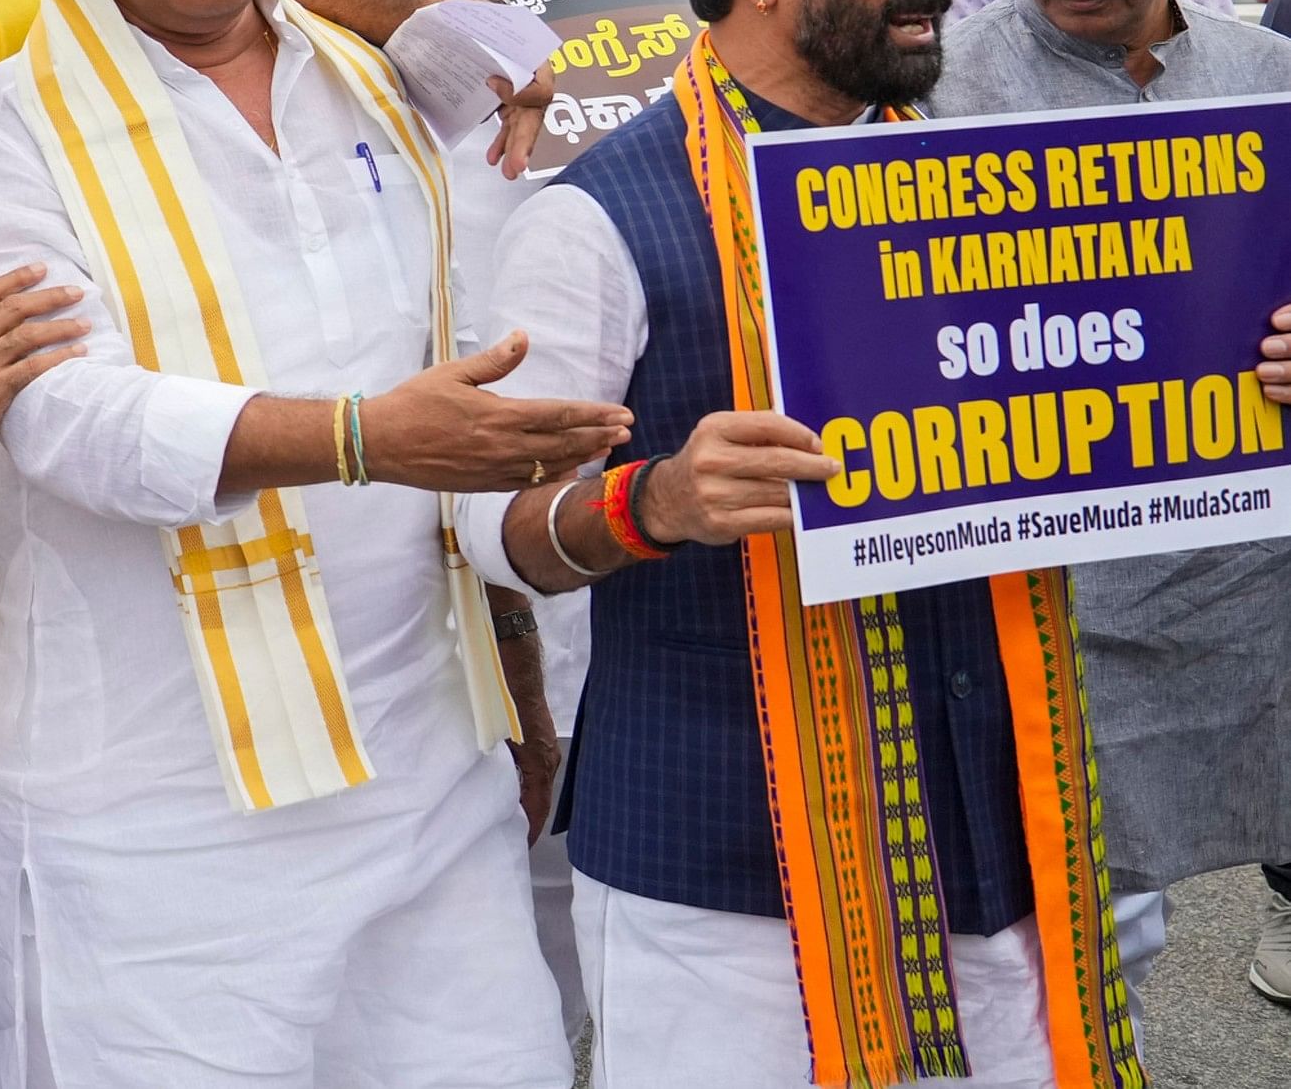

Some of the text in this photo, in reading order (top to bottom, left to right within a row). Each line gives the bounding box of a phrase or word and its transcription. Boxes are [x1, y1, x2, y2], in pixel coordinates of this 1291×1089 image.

[795, 131, 1267, 232] CONGRESS RETURNS
[878, 216, 1193, 300] in KARNATAKA
[937, 302, 1144, 380] so does
[820, 370, 1285, 508] CORRUPTION
[853, 487, 1272, 567] #AlleyesonMuda #SaveMuda #MudaScam
